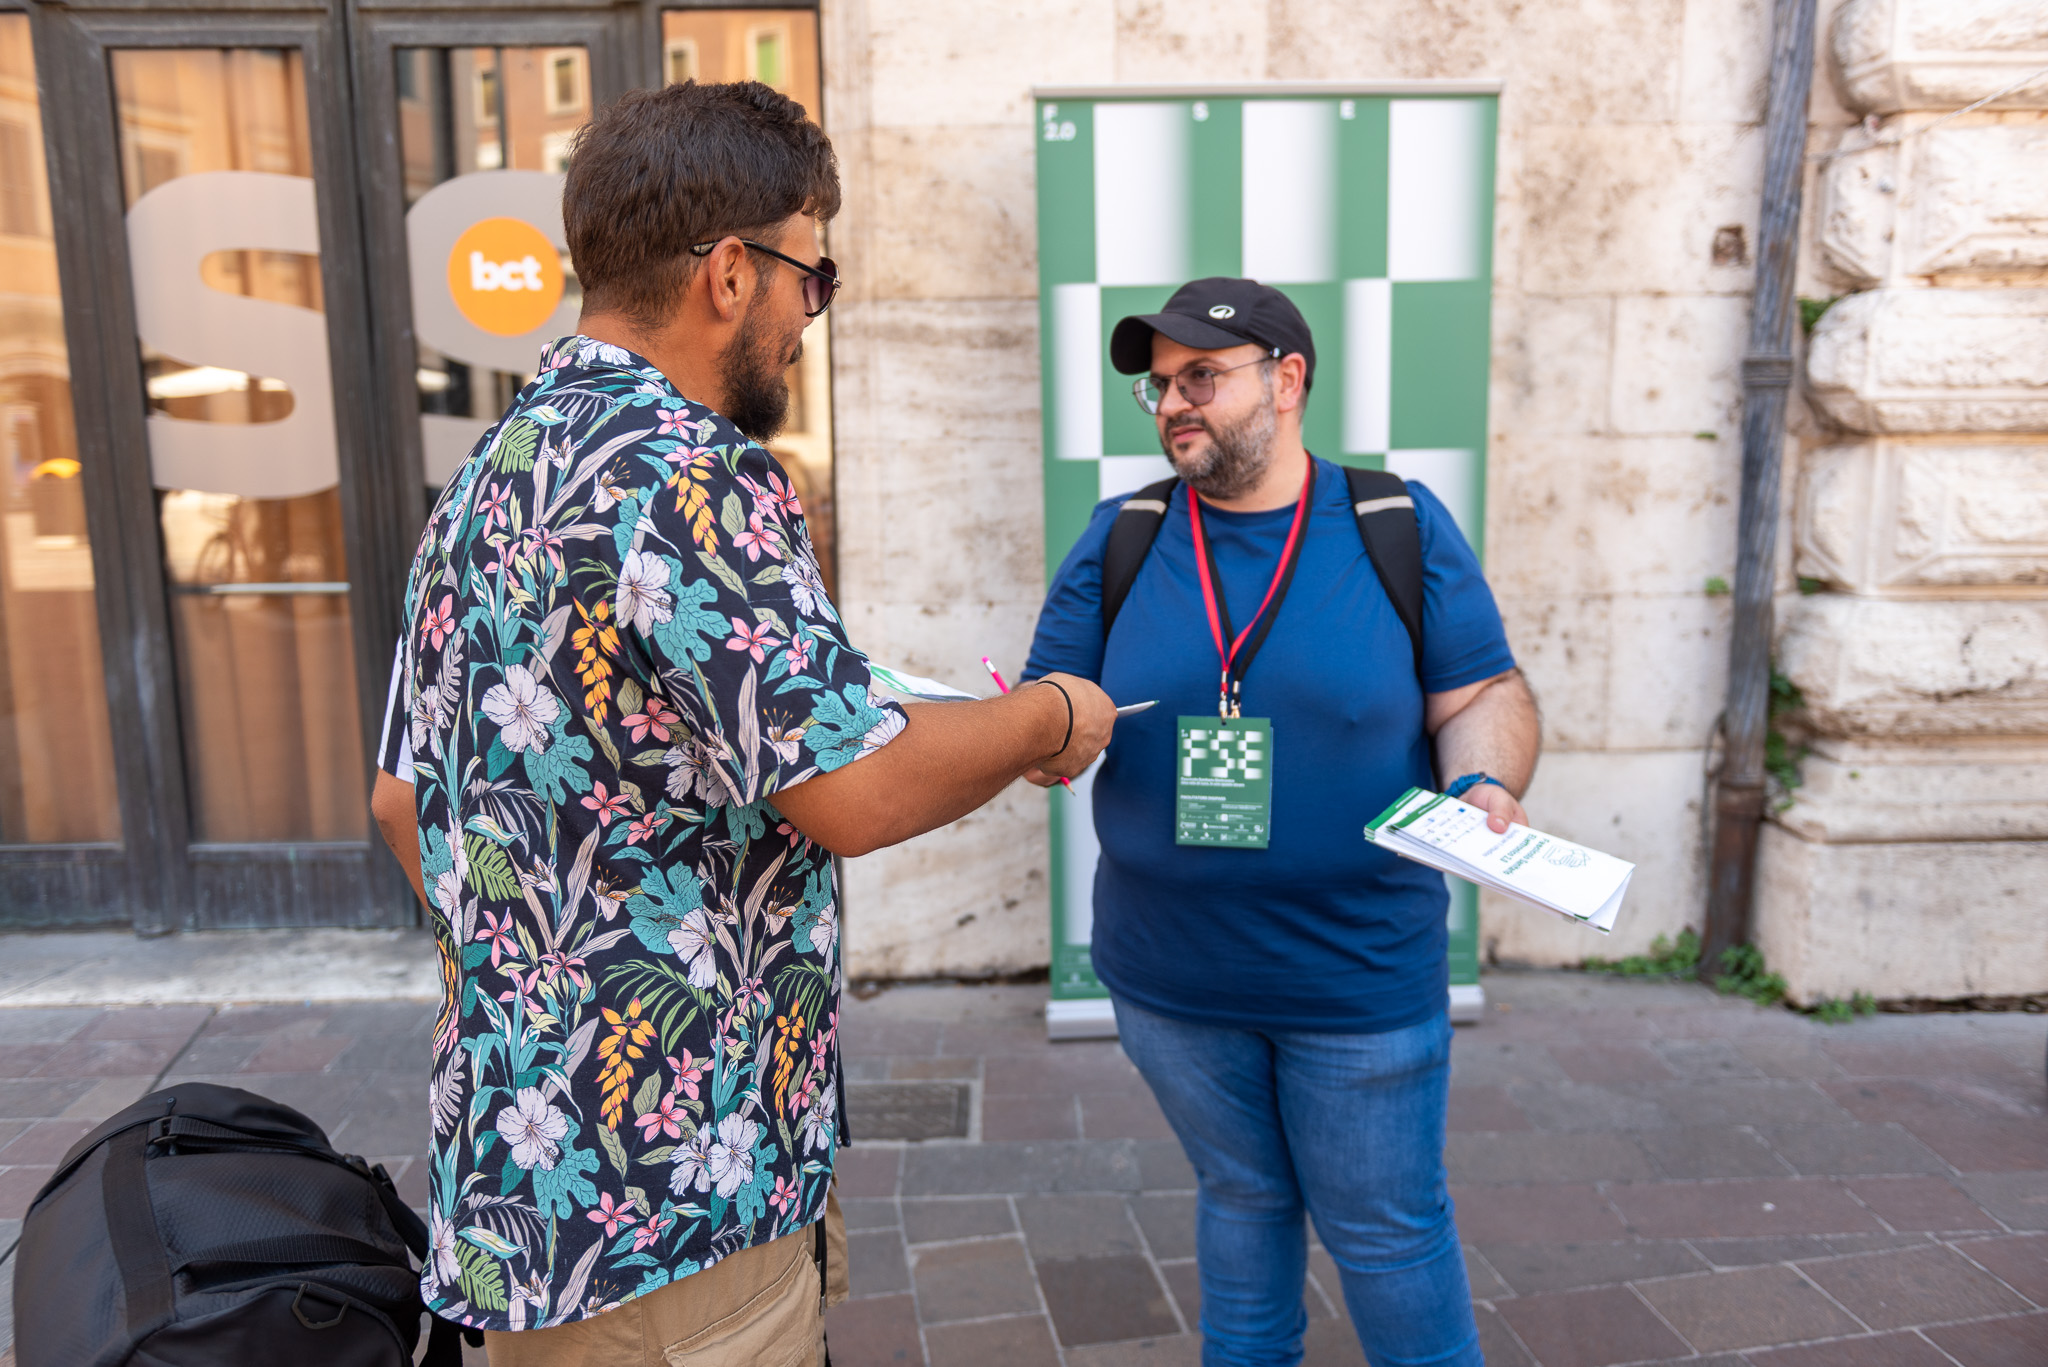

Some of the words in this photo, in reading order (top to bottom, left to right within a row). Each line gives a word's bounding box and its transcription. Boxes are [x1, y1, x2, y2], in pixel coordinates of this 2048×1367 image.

[1043, 105, 1058, 121] F
[1192, 102, 1209, 121] S
[1341, 101, 1356, 120] E
[1043, 122, 1076, 141] 2.0
[469, 251, 542, 292] bct
